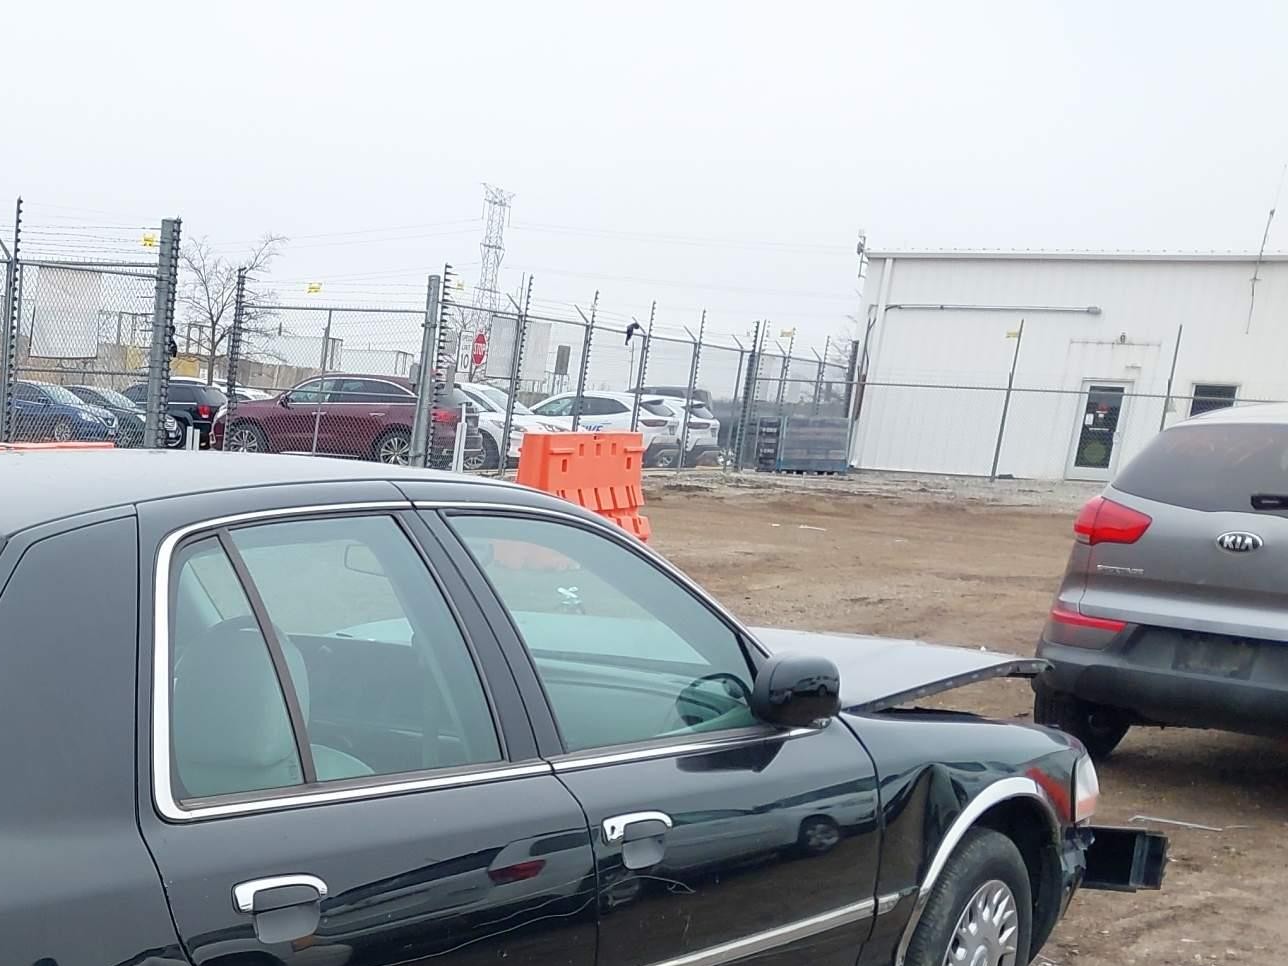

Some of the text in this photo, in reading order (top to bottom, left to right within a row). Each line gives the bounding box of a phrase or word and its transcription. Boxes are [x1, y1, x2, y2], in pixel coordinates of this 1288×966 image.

[473, 342, 486, 355] STOP
[460, 353, 470, 369] 10
[1223, 535, 1255, 550] KIA
